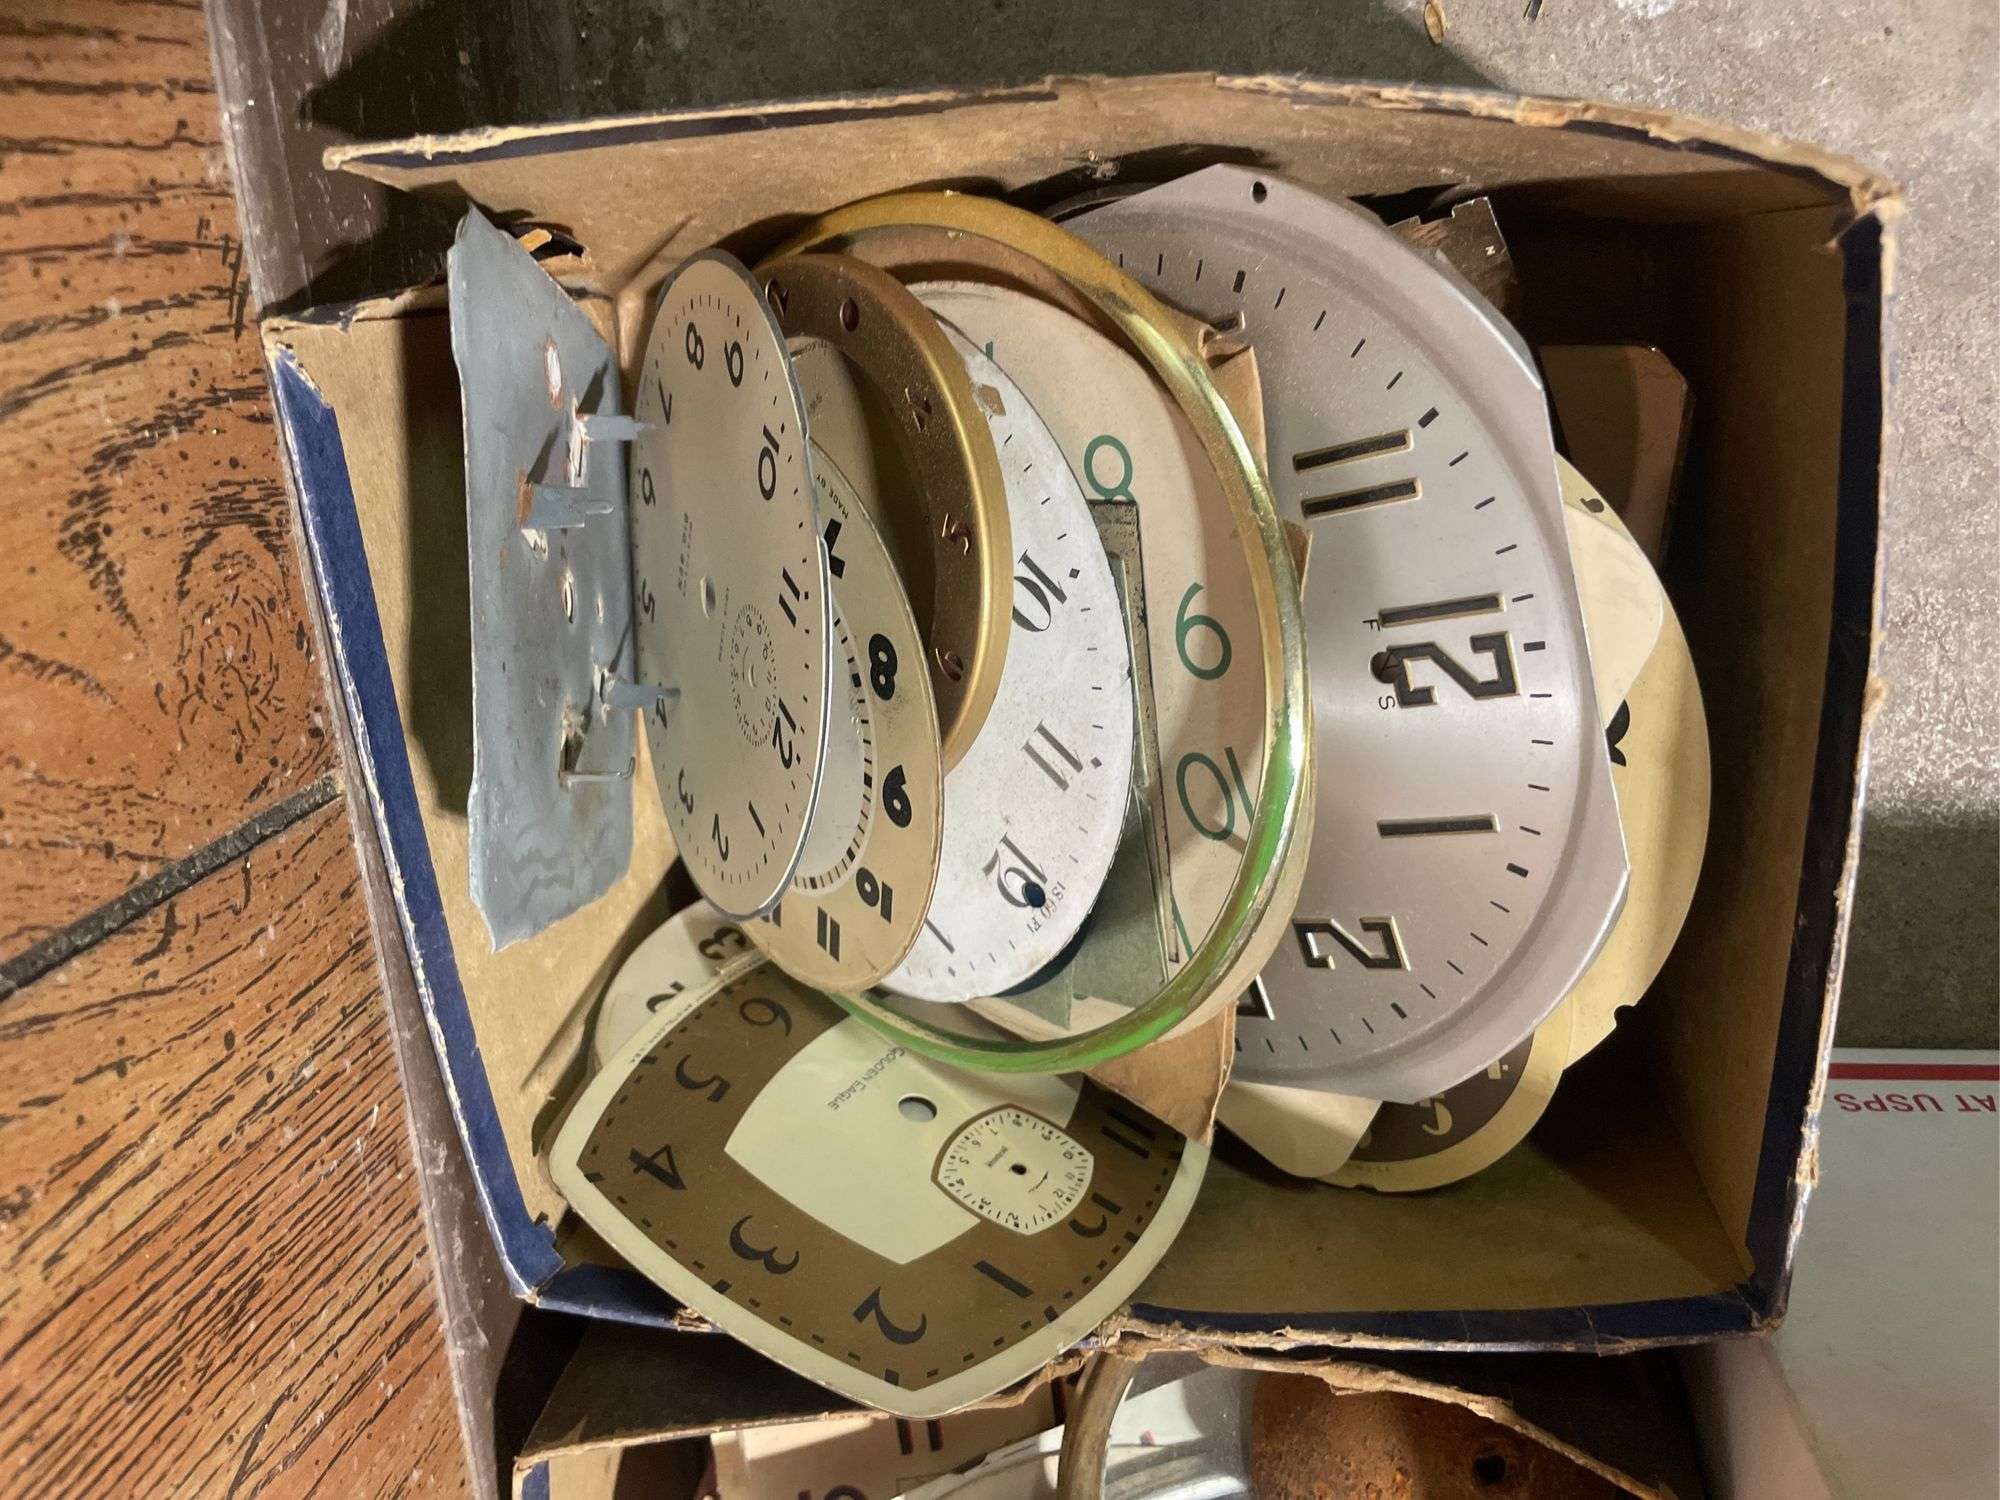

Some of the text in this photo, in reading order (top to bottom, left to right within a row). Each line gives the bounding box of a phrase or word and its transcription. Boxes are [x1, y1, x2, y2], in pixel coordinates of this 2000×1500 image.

[685, 321, 705, 370] 8
[724, 339, 744, 388] 9
[657, 377, 673, 425] 7
[757, 424, 780, 501] 10
[1292, 427, 1423, 520] 11
[641, 467, 656, 508] 6
[829, 485, 849, 519] MADE
[641, 578, 655, 624] 5
[778, 567, 801, 628] 11
[1362, 618, 1381, 632] F
[868, 633, 898, 701] 8
[1378, 593, 1521, 709] 12
[1378, 695, 1396, 710] S
[771, 698, 797, 770] 12
[1021, 719, 1084, 792] 11
[678, 768, 694, 815] 3
[882, 764, 913, 828] 9
[1175, 746, 1256, 841] 10
[711, 813, 729, 862] 2
[748, 800, 765, 838] 1
[1377, 813, 1501, 839] 1
[981, 831, 1048, 908] 12
[856, 867, 894, 924] 10
[698, 926, 748, 961] 3
[817, 906, 841, 962] 11
[1293, 915, 1411, 972] 2
[675, 1054, 731, 1103] 5
[827, 1046, 906, 1111] GOLDEN EAGLE
[1833, 1093, 1998, 1113] AT USPS
[629, 1144, 688, 1190] 4
[729, 1214, 800, 1275] 3
[972, 1259, 1035, 1299] 1
[852, 1286, 928, 1345] 2
